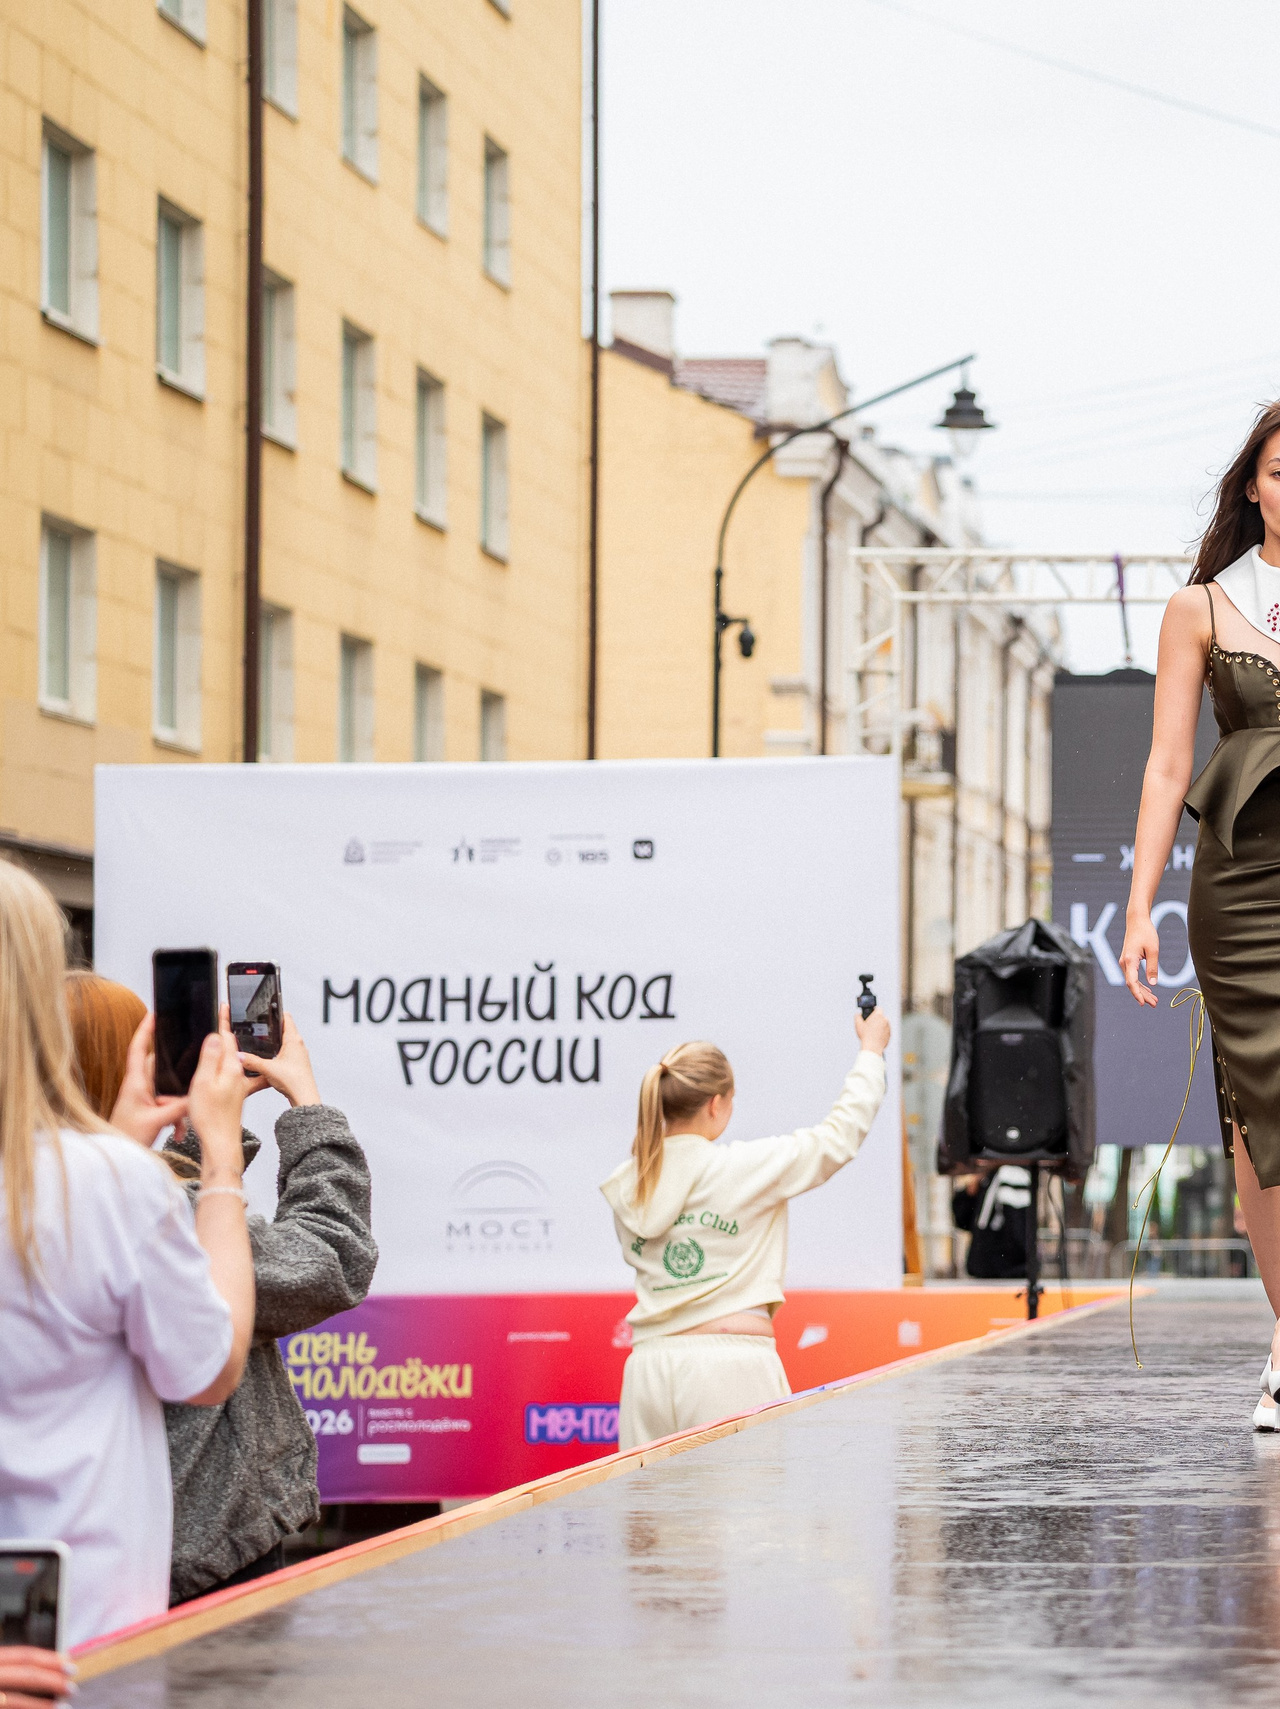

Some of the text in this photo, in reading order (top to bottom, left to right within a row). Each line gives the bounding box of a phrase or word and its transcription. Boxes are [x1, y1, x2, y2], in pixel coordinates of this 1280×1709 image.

[322, 962, 676, 1024] МОДНЫЙ КОД
[396, 1037, 601, 1086] РОССИИ
[446, 1218, 557, 1239] МОСТ
[700, 1210, 739, 1236] Club
[303, 1408, 354, 1436] 026
